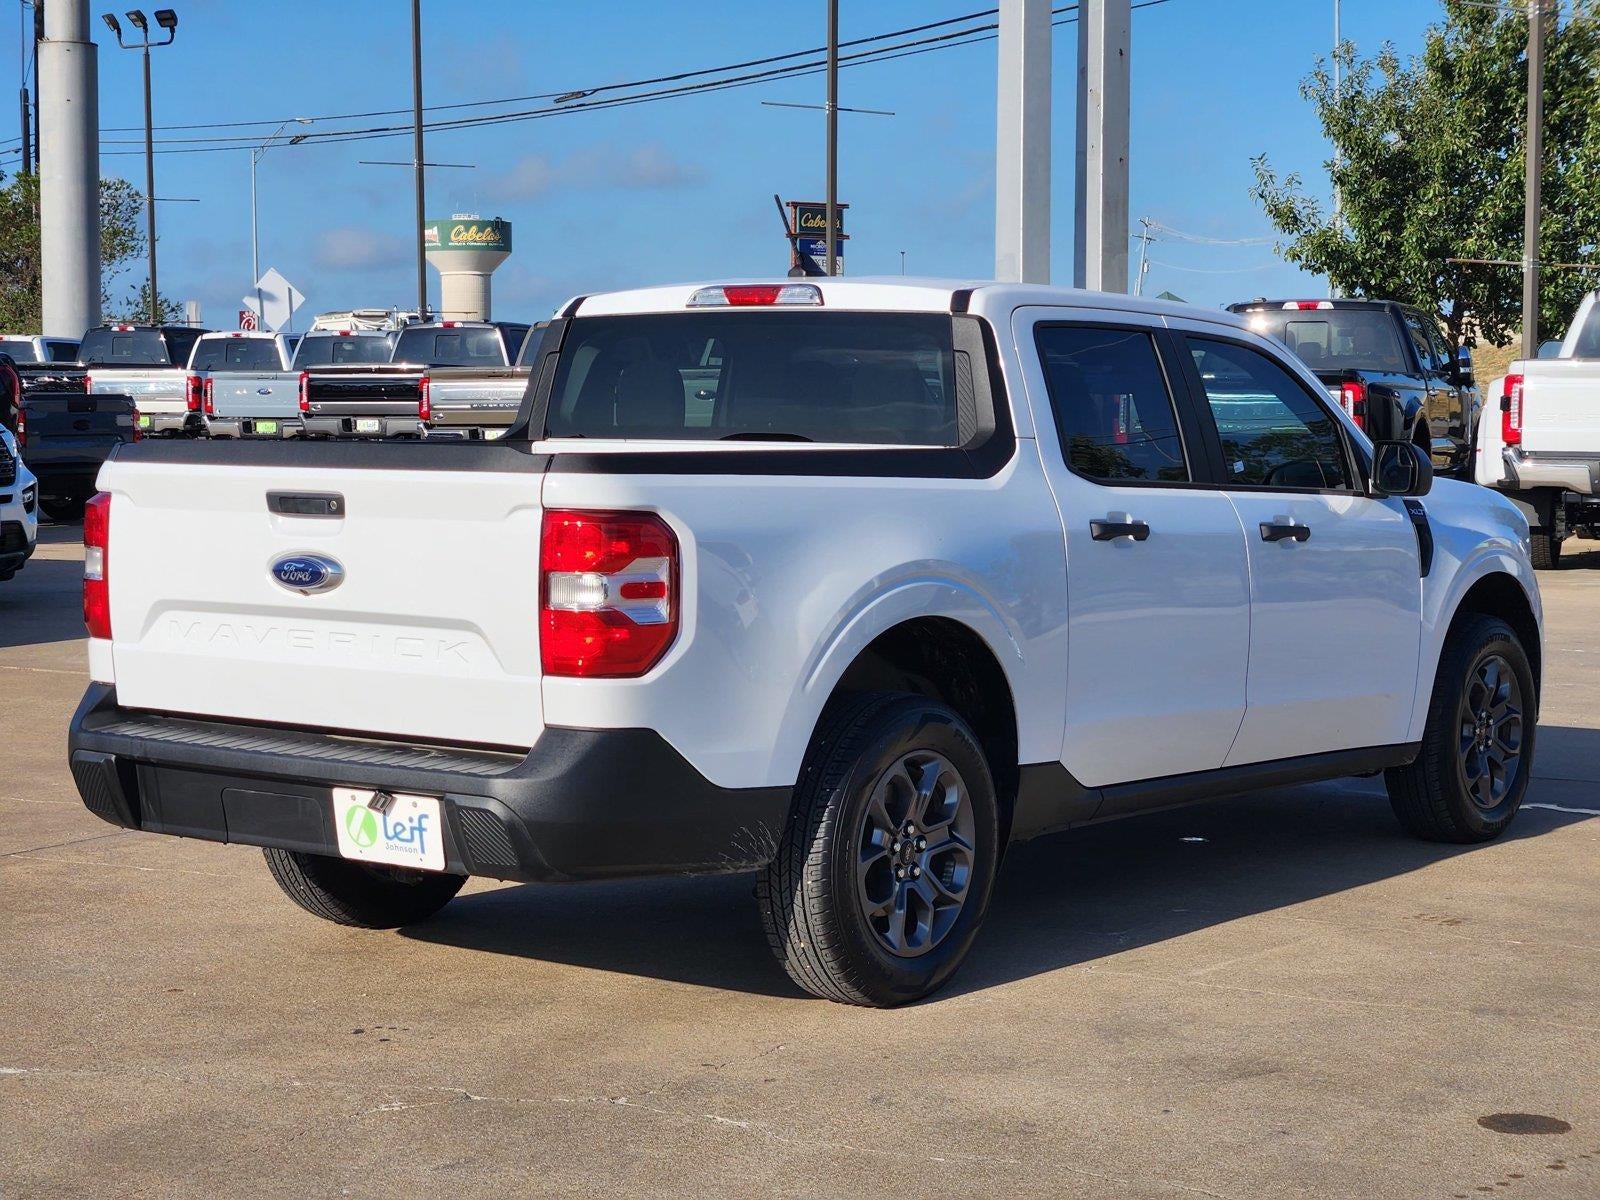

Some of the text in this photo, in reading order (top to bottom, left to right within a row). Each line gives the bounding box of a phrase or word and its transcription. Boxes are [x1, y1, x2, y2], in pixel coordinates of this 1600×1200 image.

[450, 224, 502, 241] Cabela's
[1409, 508, 1424, 516] XLT
[280, 562, 312, 583] Ford
[168, 619, 470, 664] MAVERICK
[385, 842, 418, 854] Johnson
